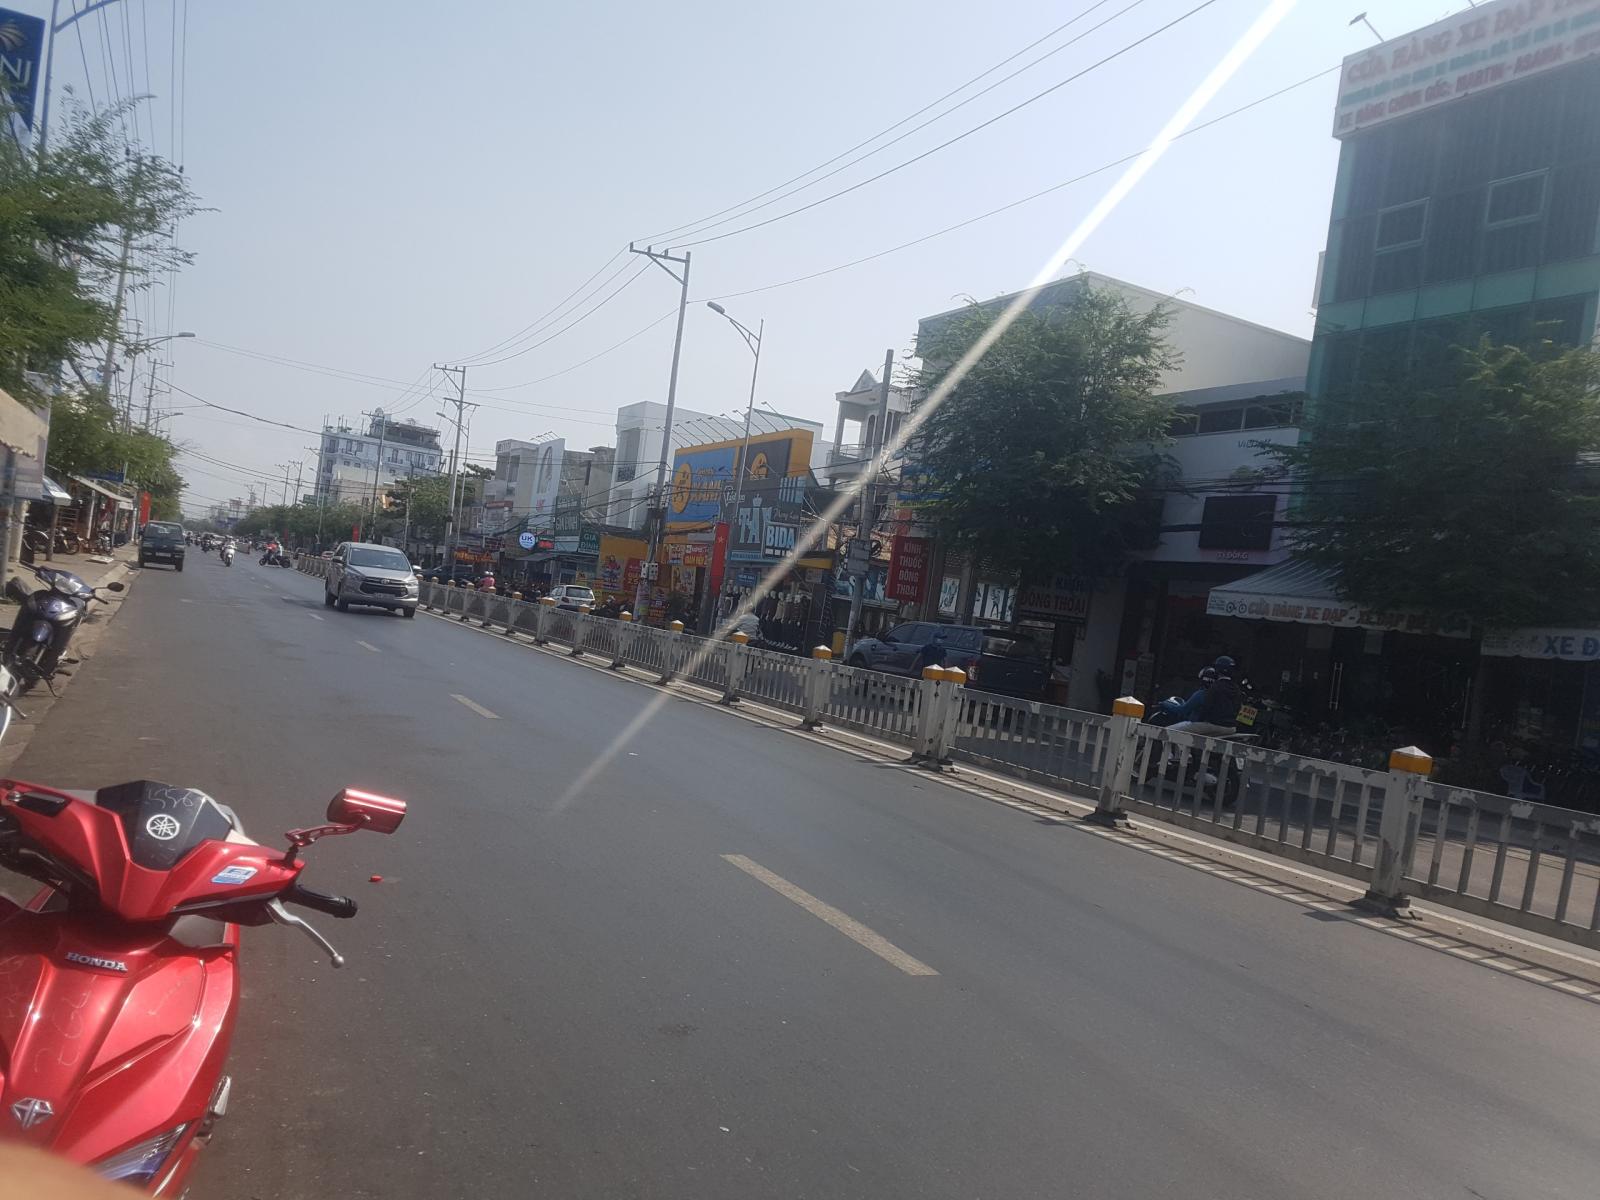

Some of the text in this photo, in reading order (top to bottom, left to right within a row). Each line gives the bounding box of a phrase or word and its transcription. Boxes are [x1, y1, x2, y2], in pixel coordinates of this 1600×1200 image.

[1391, 36, 1452, 70] HÀNG
[1456, 14, 1488, 46] XE
[766, 525, 795, 549] BIDA
[1247, 598, 1270, 616] CỬA
[1271, 600, 1304, 619] HÀNG
[1542, 635, 1576, 656] XE
[65, 951, 129, 973] HONDA
